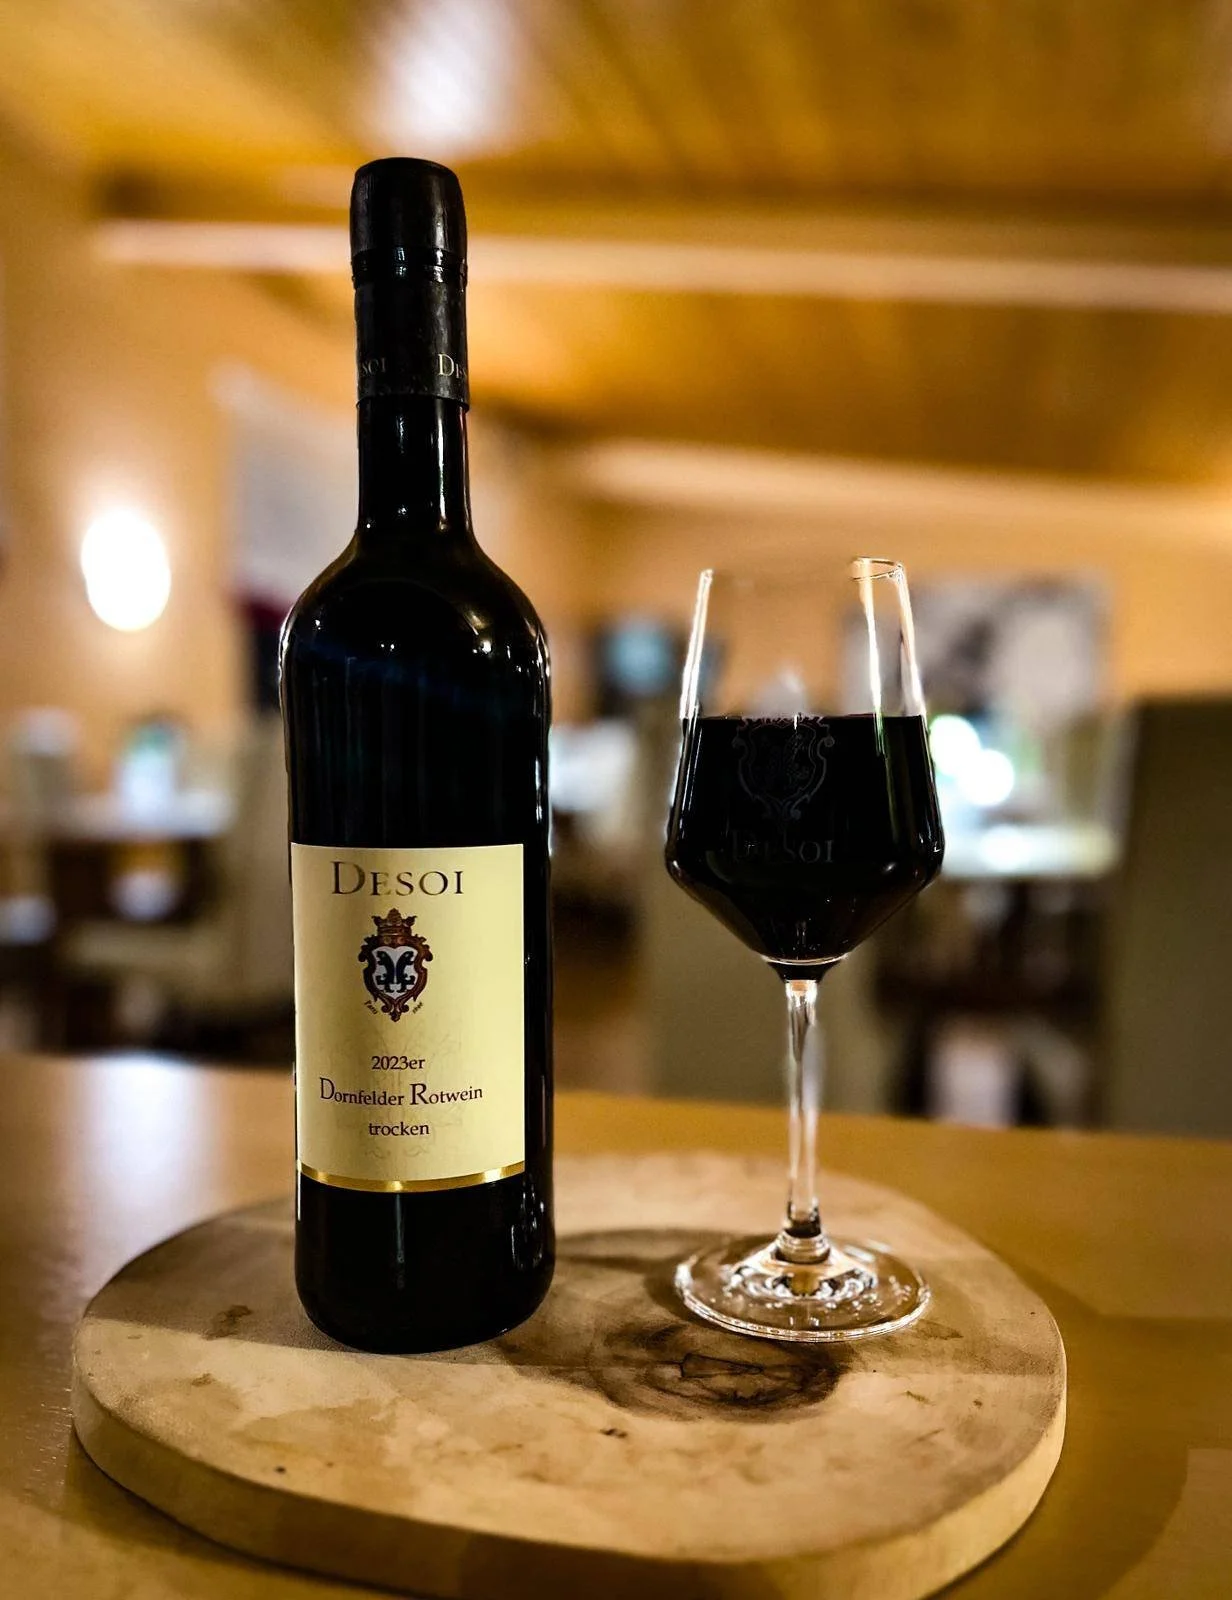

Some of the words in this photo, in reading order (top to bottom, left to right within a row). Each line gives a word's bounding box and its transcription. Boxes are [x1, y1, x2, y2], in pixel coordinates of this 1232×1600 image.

[330, 860, 465, 897] DESOI
[371, 1055, 426, 1071] 2023er
[319, 1077, 405, 1107] Dornfelder
[409, 1082, 484, 1106] Rotwein
[368, 1121, 430, 1137] trocken
